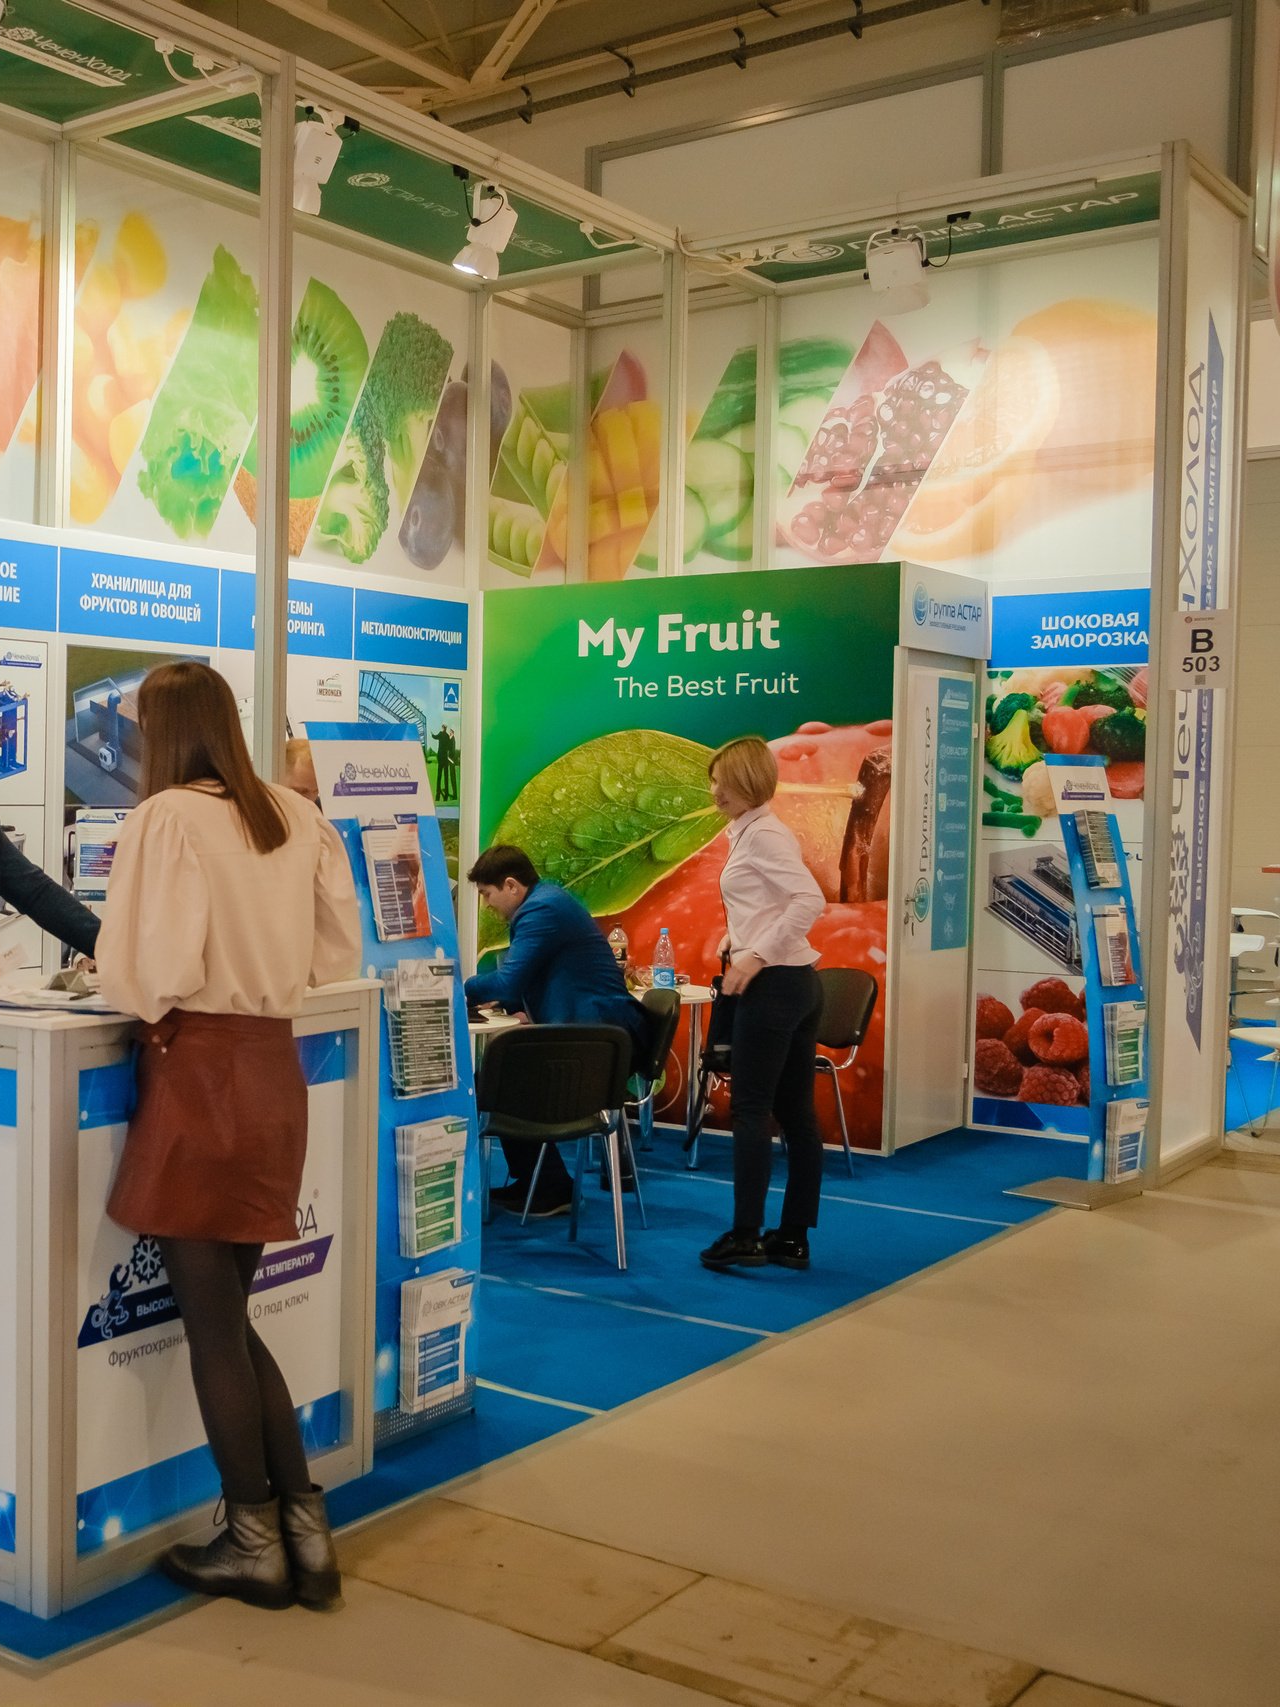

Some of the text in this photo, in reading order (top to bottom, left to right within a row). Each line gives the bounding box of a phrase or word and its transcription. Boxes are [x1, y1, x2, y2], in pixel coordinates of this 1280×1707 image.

[997, 192, 1139, 225] АСТАР
[91, 572, 192, 602] ХРАНИЛИЩА ДЛЯ
[79, 593, 202, 623] ФРУКТОВ И ОВОЩЕЙ
[929, 598, 982, 622] Группа АСТАР
[361, 621, 463, 646] МЕТАЛЛОКОНСТРУКЦИИ
[1041, 612, 1139, 631] ШОКОВАЯ
[577, 609, 780, 668] My Fruit
[1030, 630, 1149, 650] ЗАМОРОЗКА
[1191, 628, 1214, 653] B
[1195, 780, 1207, 901] ВЫСОКОЕ
[1207, 379, 1219, 537] ТЕМПЕРАТУР
[1182, 656, 1220, 673] 503
[614, 672, 799, 698] The Best Fruit
[266, 1252, 315, 1277] ТЕМПЕРАТУР
[264, 1300, 283, 1316] под
[285, 1291, 309, 1310] ключ
